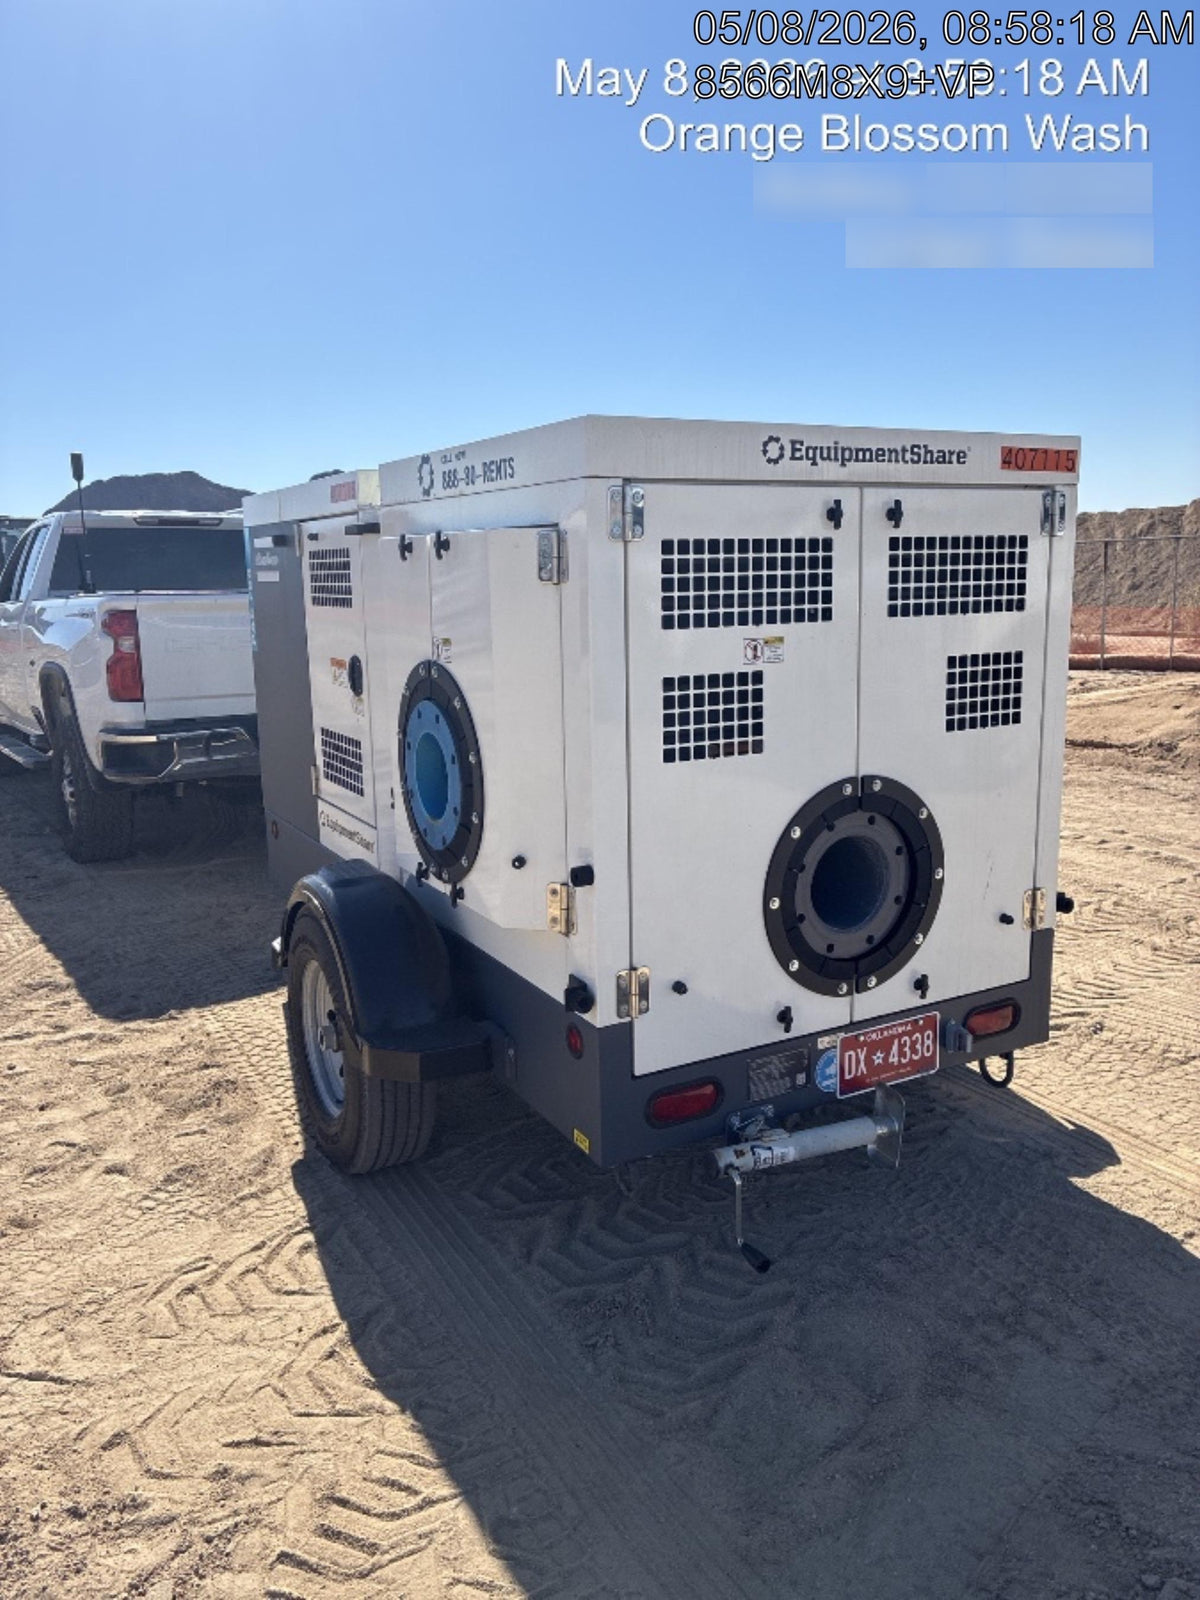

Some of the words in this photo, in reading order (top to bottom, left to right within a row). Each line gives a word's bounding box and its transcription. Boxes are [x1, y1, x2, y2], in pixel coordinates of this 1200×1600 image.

[789, 439, 968, 467] EquipmentShare
[1001, 446, 1076, 473] 407115
[844, 1046, 868, 1080] DX
[888, 1030, 933, 1066] 4338
